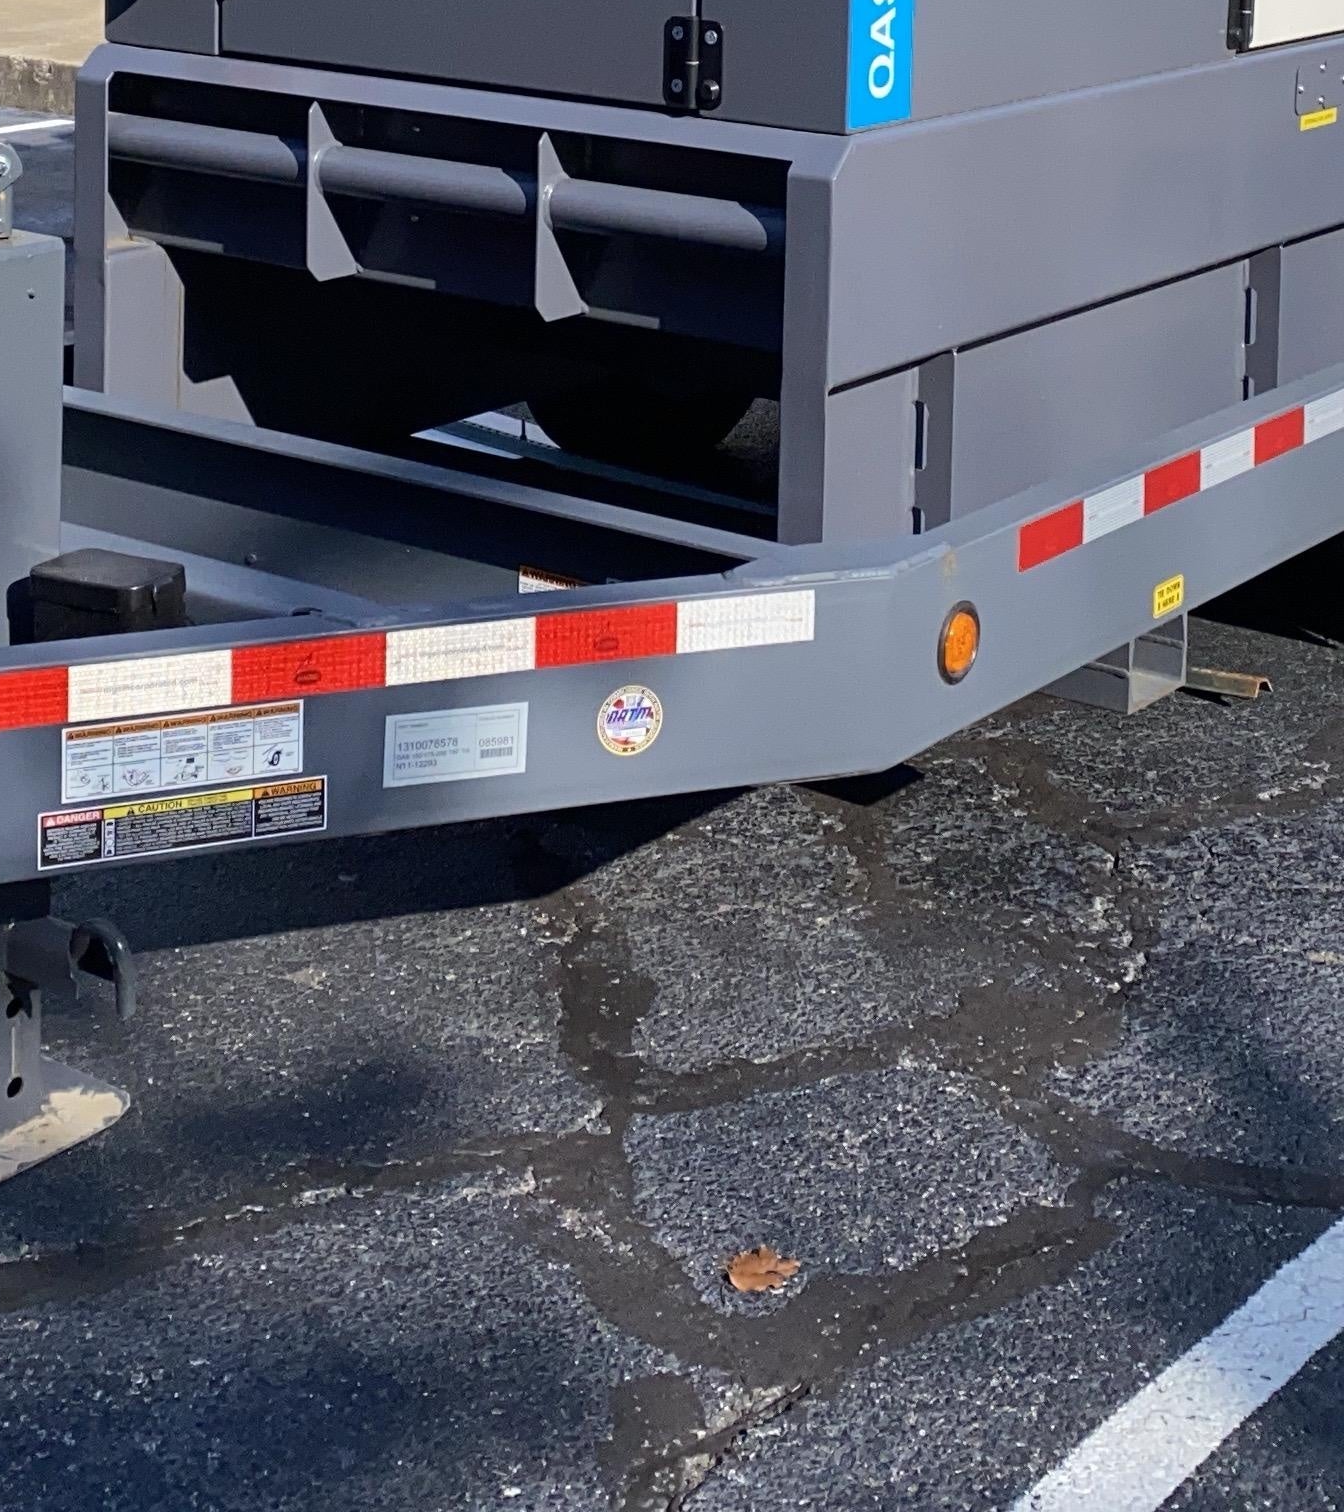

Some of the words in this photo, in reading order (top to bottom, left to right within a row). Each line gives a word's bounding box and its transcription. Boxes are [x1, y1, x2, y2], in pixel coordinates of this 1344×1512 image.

[271, 782, 317, 796] WARNING
[138, 800, 183, 813] CAUTION
[58, 811, 101, 825] DANGER
